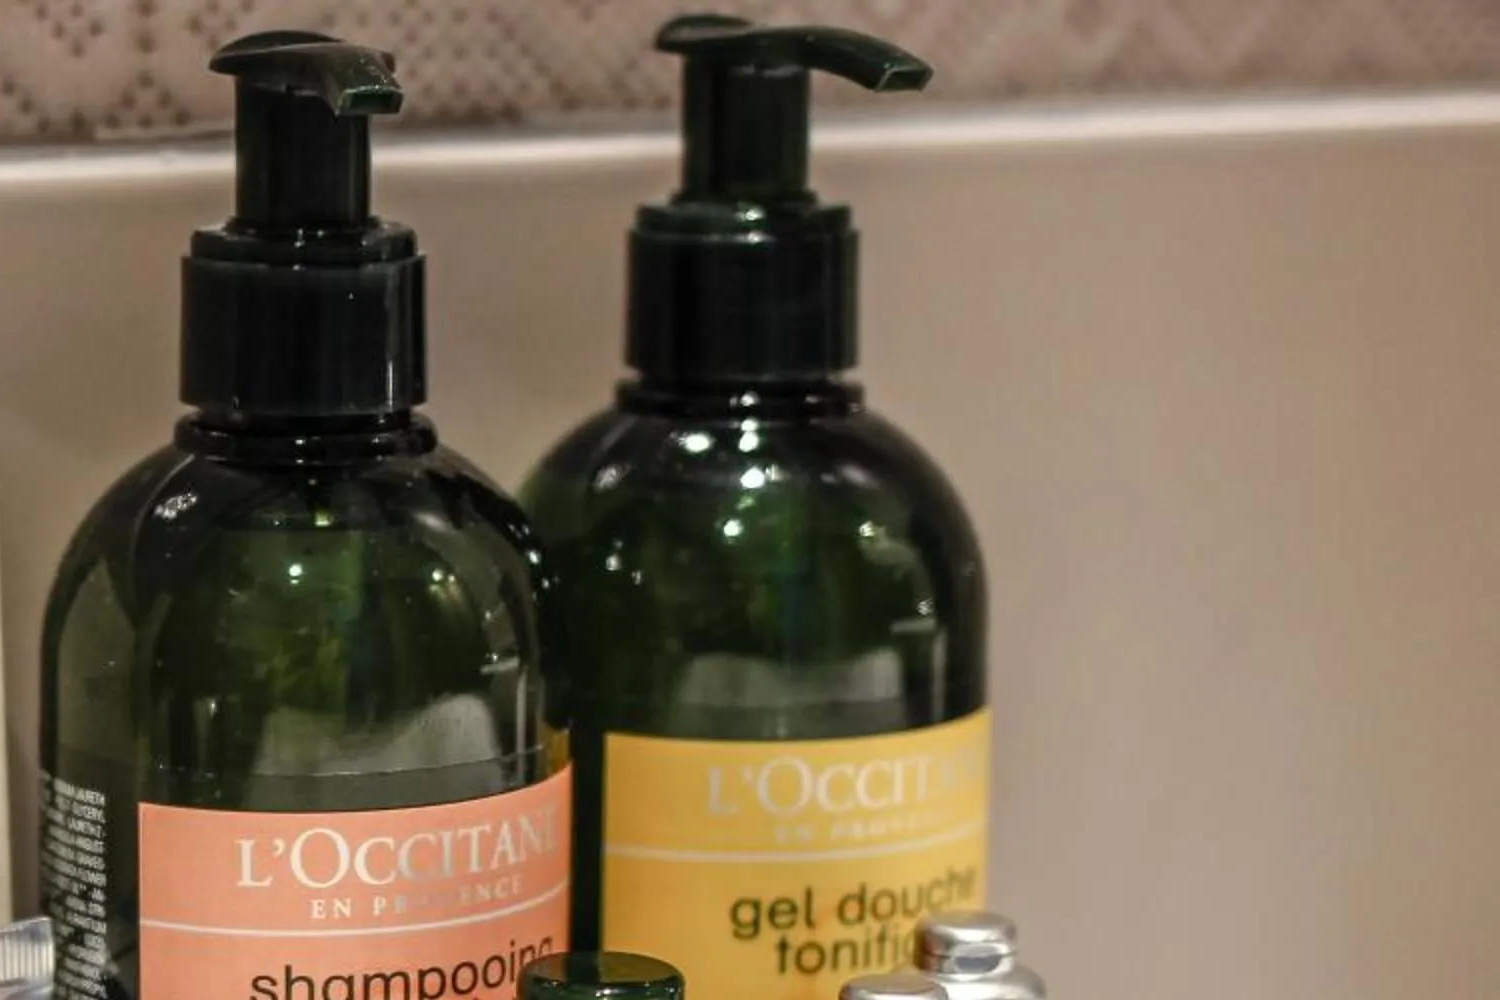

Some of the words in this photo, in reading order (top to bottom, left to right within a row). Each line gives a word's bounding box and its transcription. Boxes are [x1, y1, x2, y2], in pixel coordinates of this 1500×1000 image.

[708, 754, 958, 817] L'OCCIT
[235, 805, 560, 889] L'OCCITANE
[311, 897, 353, 920] EN
[373, 873, 523, 917] PRENCE
[728, 884, 817, 940] gel
[775, 923, 916, 977] tonifi
